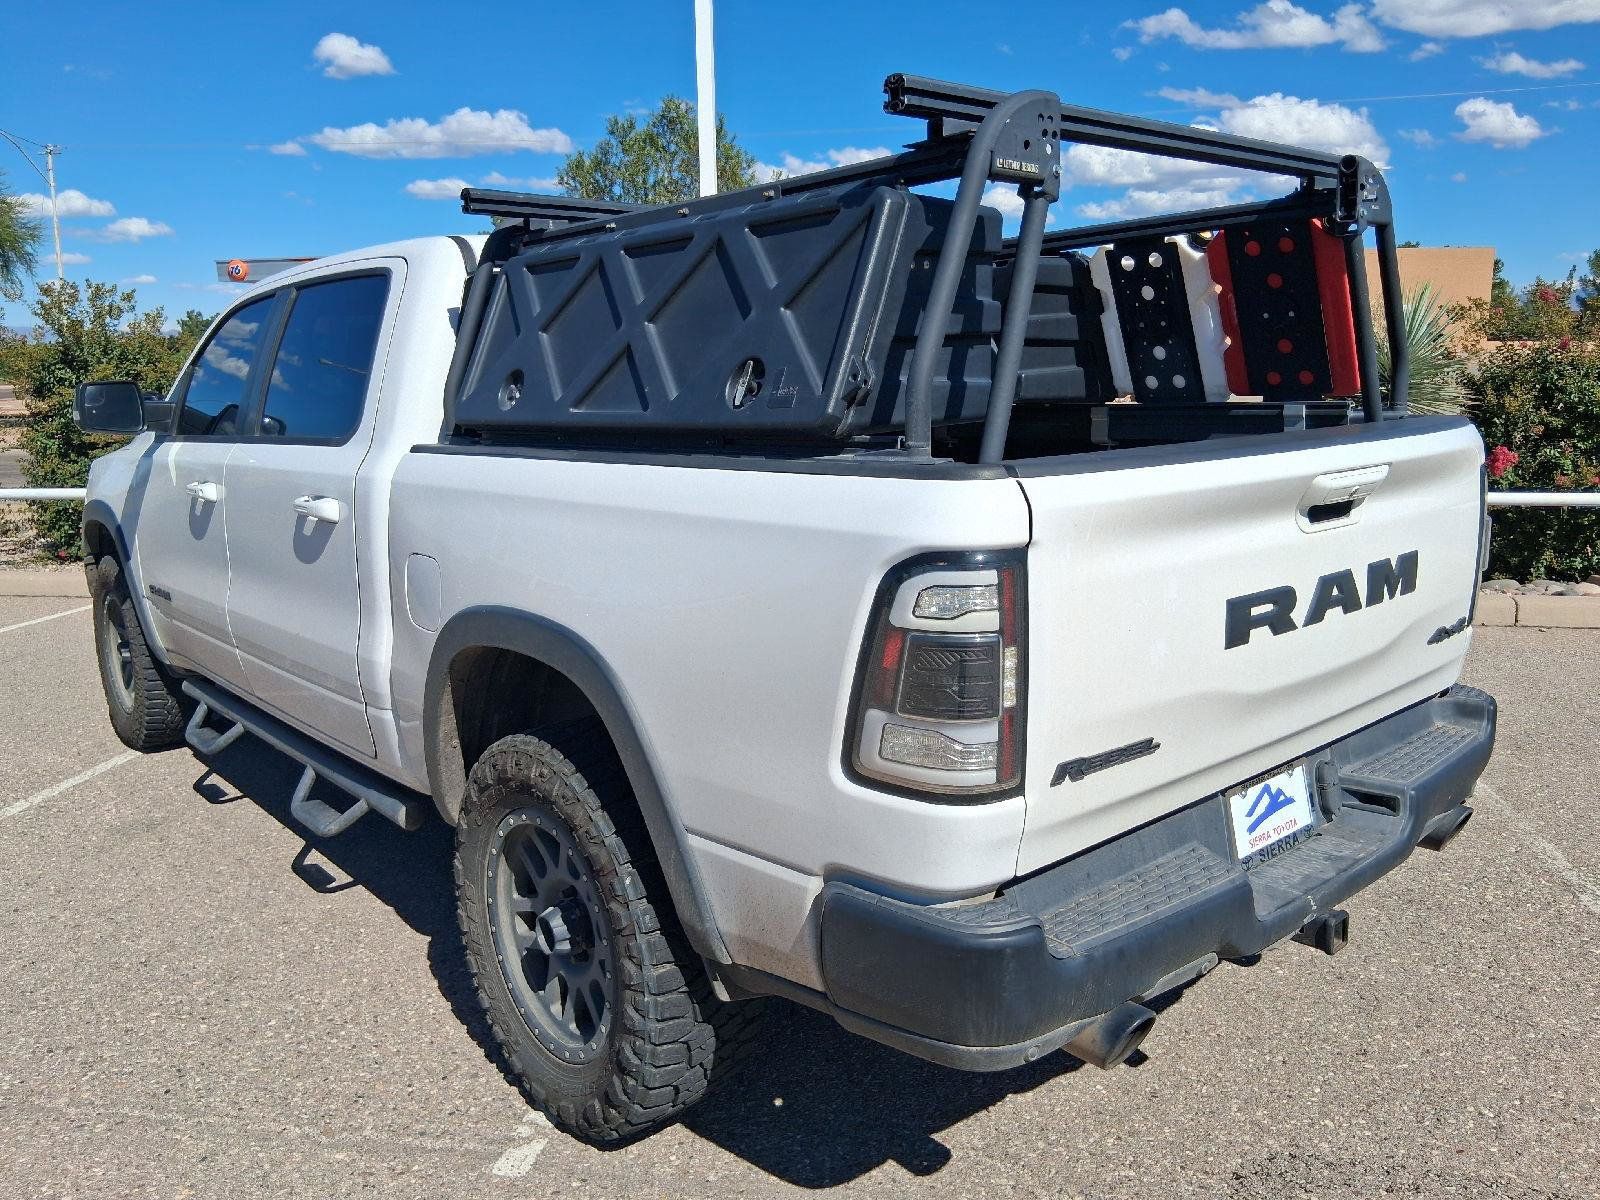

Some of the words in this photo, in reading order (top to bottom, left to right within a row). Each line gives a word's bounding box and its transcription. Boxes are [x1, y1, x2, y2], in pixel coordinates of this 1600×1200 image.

[229, 264, 241, 276] 76
[1224, 549, 1419, 650] RAM
[1248, 830, 1272, 849] SIERRA
[1272, 818, 1298, 836] TOYOTA
[1258, 833, 1300, 863] SIERRA
